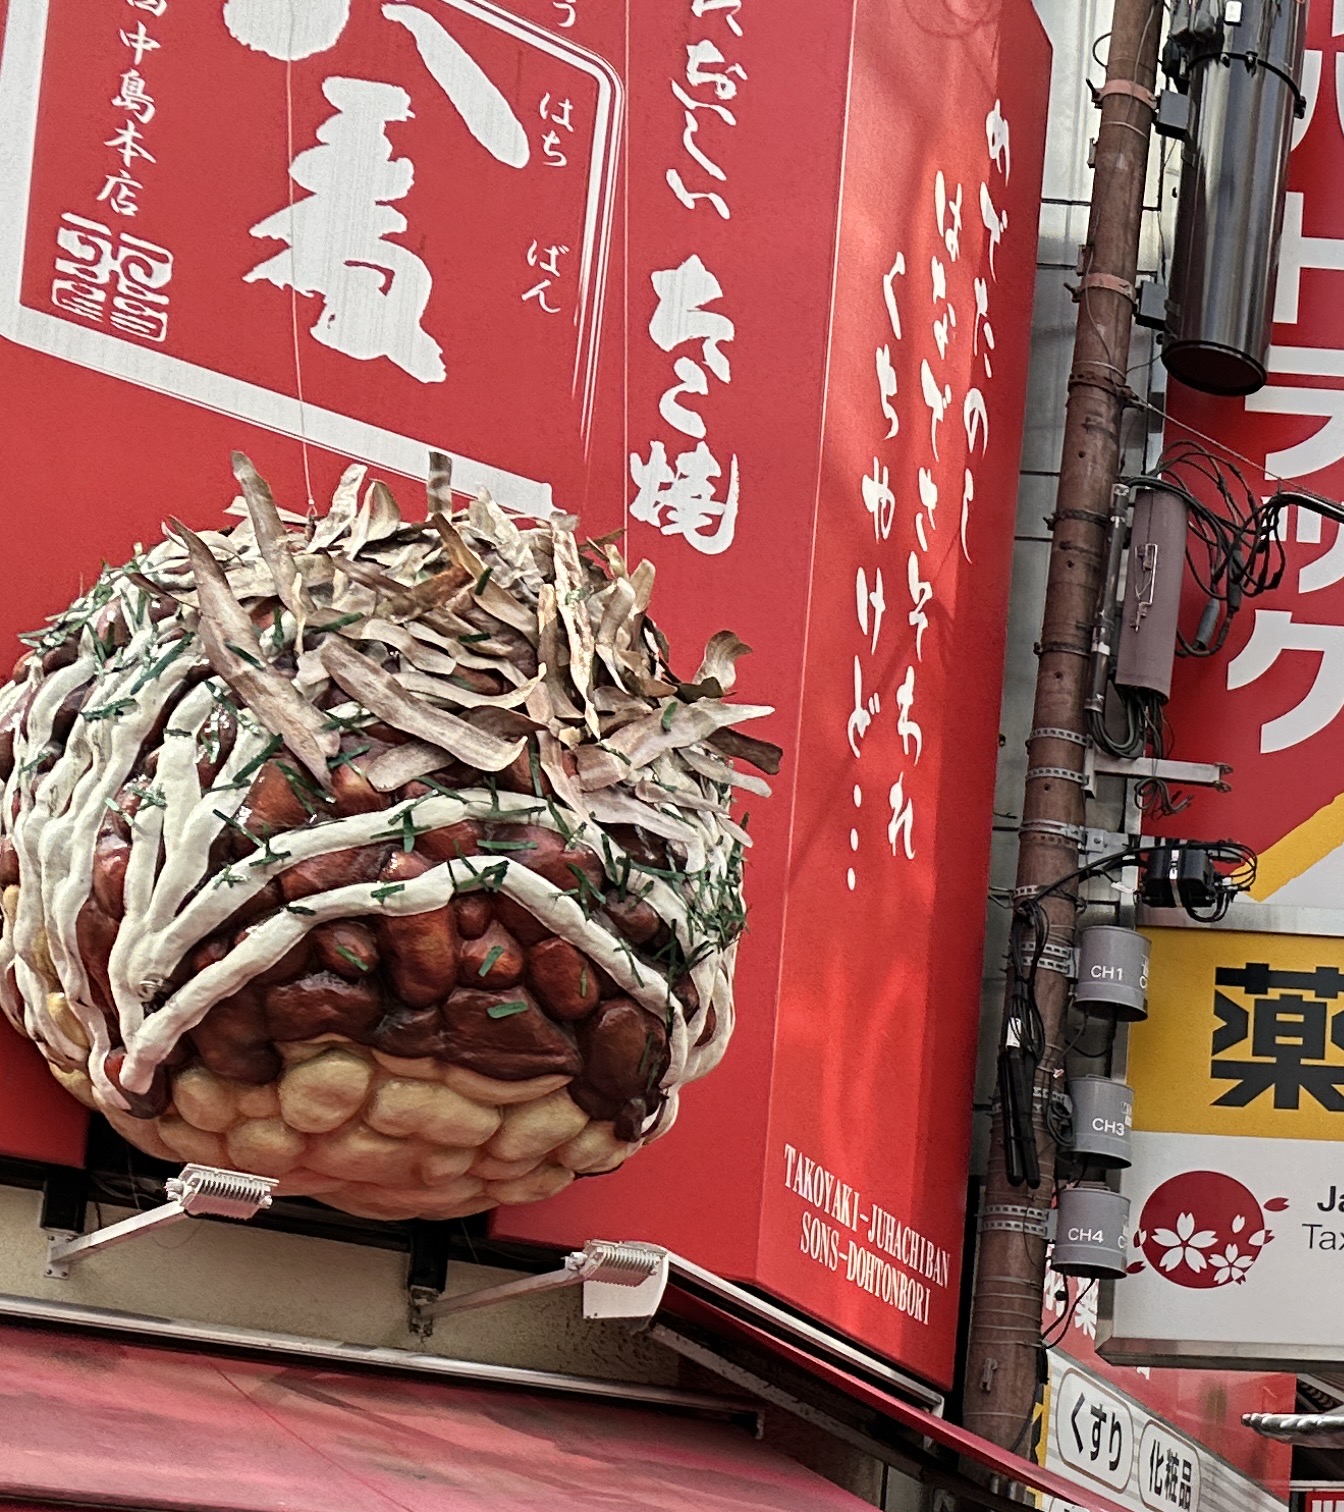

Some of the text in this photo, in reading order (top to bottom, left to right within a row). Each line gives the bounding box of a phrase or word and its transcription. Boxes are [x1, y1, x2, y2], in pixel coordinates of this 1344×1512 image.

[521, 239, 563, 316] ばん
[1090, 964, 1124, 981] CH1
[1092, 1117, 1125, 1137] CH3
[784, 1143, 951, 1290] TAKOYAKI-JUHACHIBAN
[1068, 1227, 1104, 1244] CH4
[799, 1210, 932, 1327] SONS-DOHTONBORI
[1071, 1391, 1123, 1472] くすり
[1149, 1438, 1193, 1512] 化粧品
